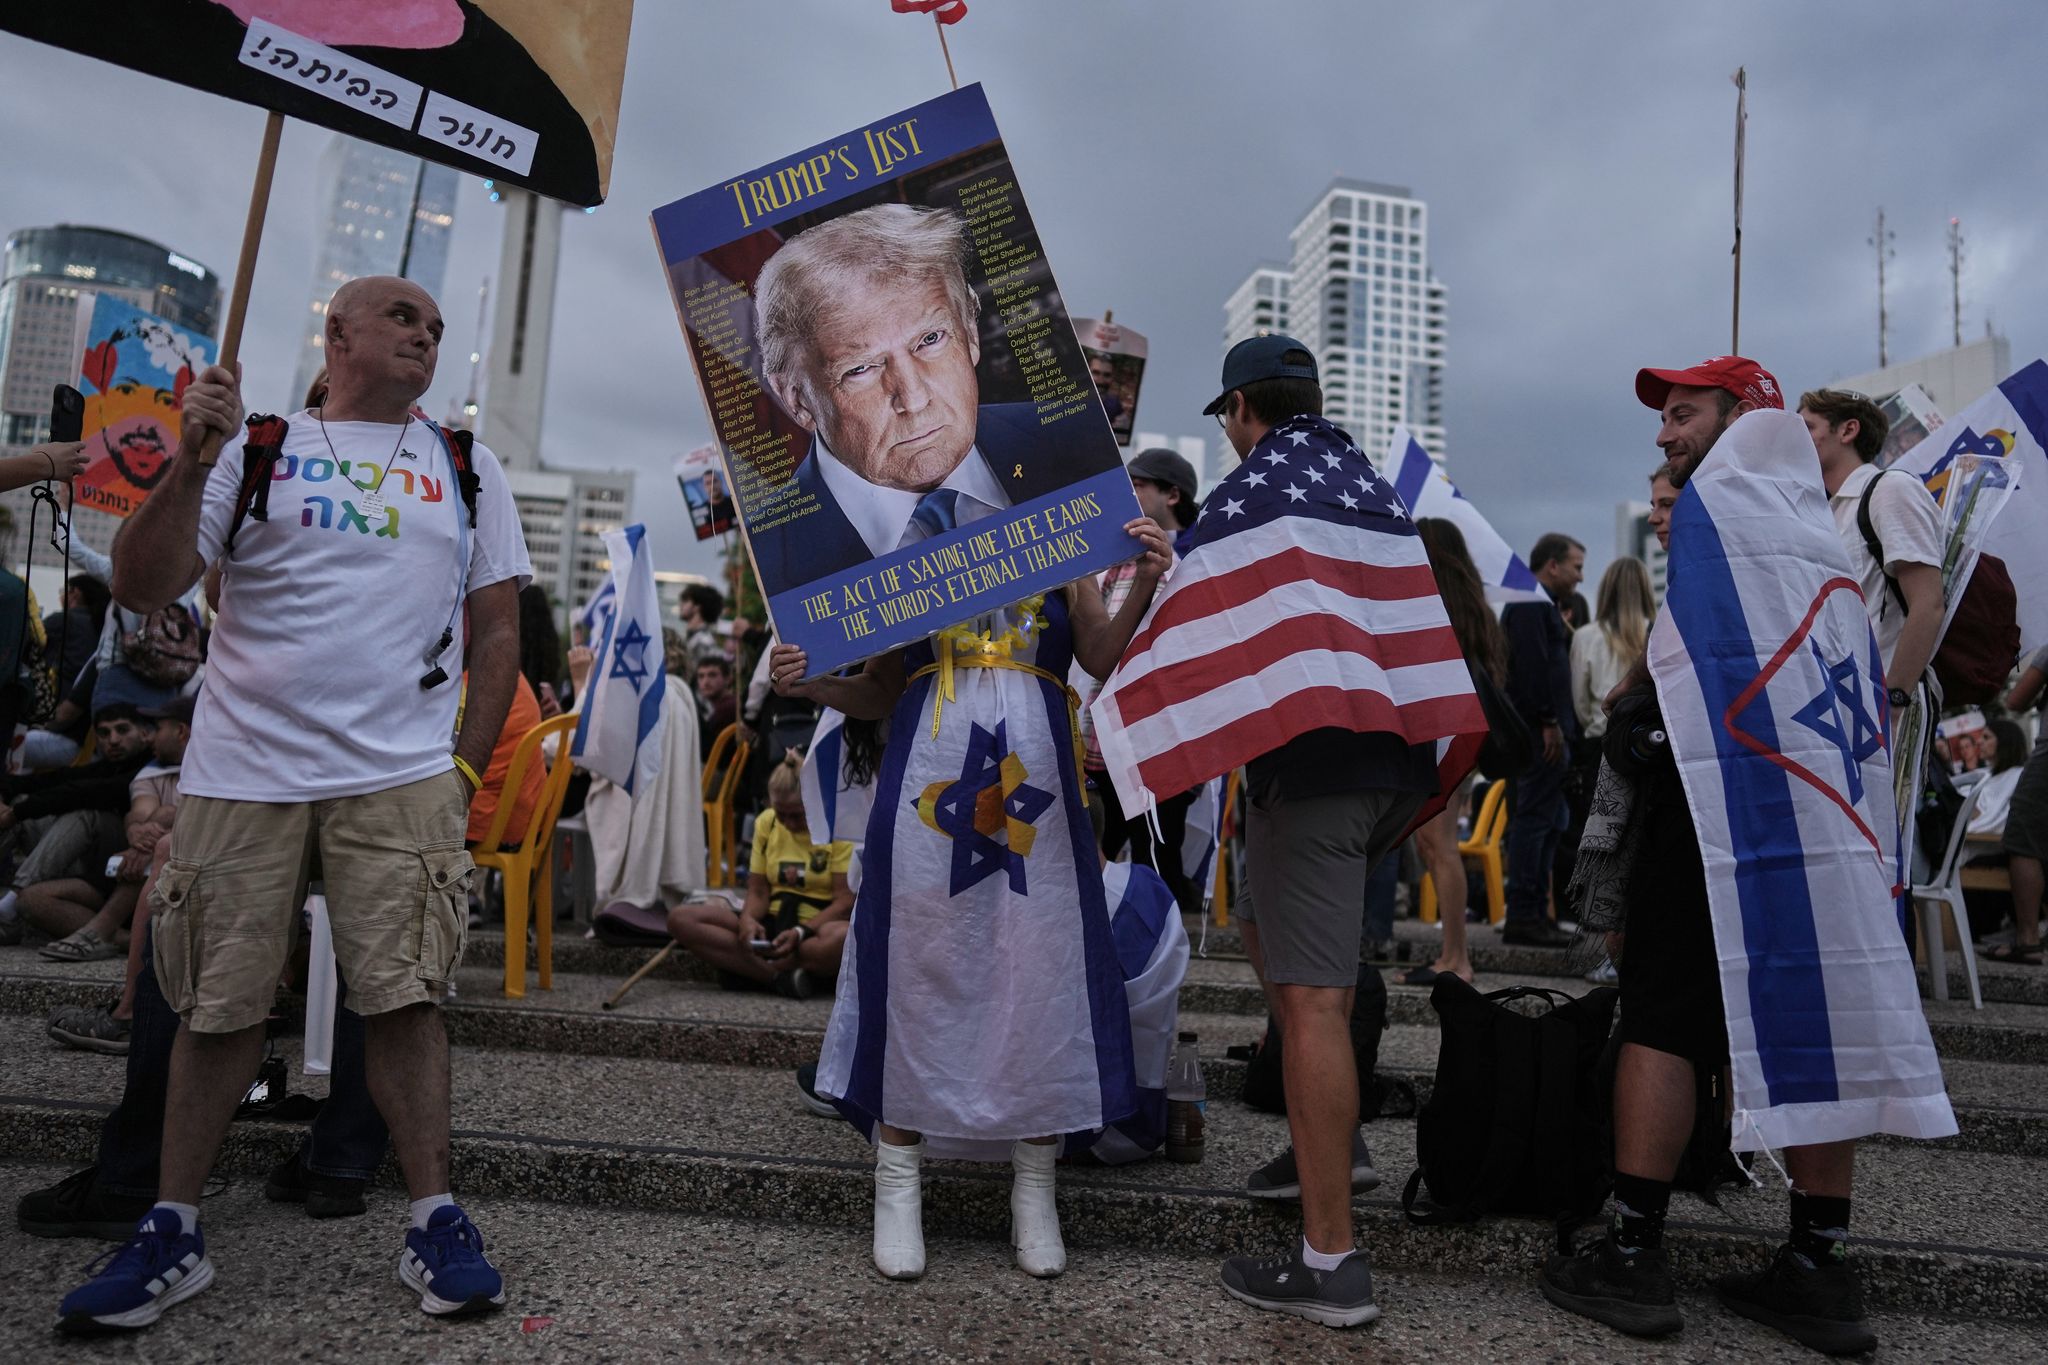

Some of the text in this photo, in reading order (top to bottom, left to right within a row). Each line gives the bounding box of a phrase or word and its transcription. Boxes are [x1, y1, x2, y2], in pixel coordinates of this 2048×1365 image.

[250, 37, 516, 160] חוזר הביתה!
[724, 119, 923, 228] TRUMP'S LIST
[958, 177, 997, 196] David Kunio
[987, 182, 1013, 196] Margalit
[989, 205, 1012, 218] Baruch
[976, 237, 989, 246] Guy
[978, 248, 988, 256] Tal
[981, 243, 1025, 265] Yossi Sharabi
[985, 251, 1037, 276] Manny Goddard
[988, 267, 1029, 286] Daniel Perez
[1006, 279, 1024, 291] Chen
[996, 286, 1039, 306] Hadar Goldin
[1000, 300, 1032, 316] Oz Daniel
[697, 318, 733, 337] Ziv Berman
[1003, 317, 1017, 327] Lior
[712, 328, 736, 342] Berman
[734, 337, 742, 345] Or
[1007, 327, 1025, 338] Omer
[1028, 328, 1051, 341] Baruch
[1015, 341, 1040, 356] Dror Or
[704, 357, 715, 368] Bar
[1019, 356, 1033, 365] Ran
[1022, 357, 1057, 375] Tamir Adar
[710, 377, 727, 388] Tamir
[1027, 366, 1061, 384] Eitan Levy
[1048, 375, 1067, 386] Kunio
[714, 385, 734, 398] Matan
[716, 387, 761, 408] Nimrod Cohen
[1034, 382, 1076, 403] Ronen Engel
[737, 402, 752, 413] Horn
[1037, 389, 1089, 414] Amiram Cooper
[723, 412, 754, 429] Alon Ohel
[1041, 412, 1063, 425] Maxim
[726, 428, 742, 440] Eitan
[729, 430, 771, 452] Eviatar David
[752, 433, 792, 453] Zalmanovich
[737, 456, 795, 483] Elkana Boochboot
[740, 469, 792, 493] Rom Breslavsky
[82, 485, 128, 511] בוחבוט
[743, 491, 764, 503] Matan
[746, 488, 800, 513] Guy Gilboa Dalal
[749, 493, 815, 523] Yosef Chaim Ochana
[301, 496, 400, 539] גאה
[752, 513, 790, 534] Muhammad
[801, 493, 1102, 624] THE ACT OF SAVING ONE LIFE EARNS
[838, 610, 875, 641] THE
[948, 558, 1024, 603] ETERNAL
[1022, 530, 1089, 573] THANKS
